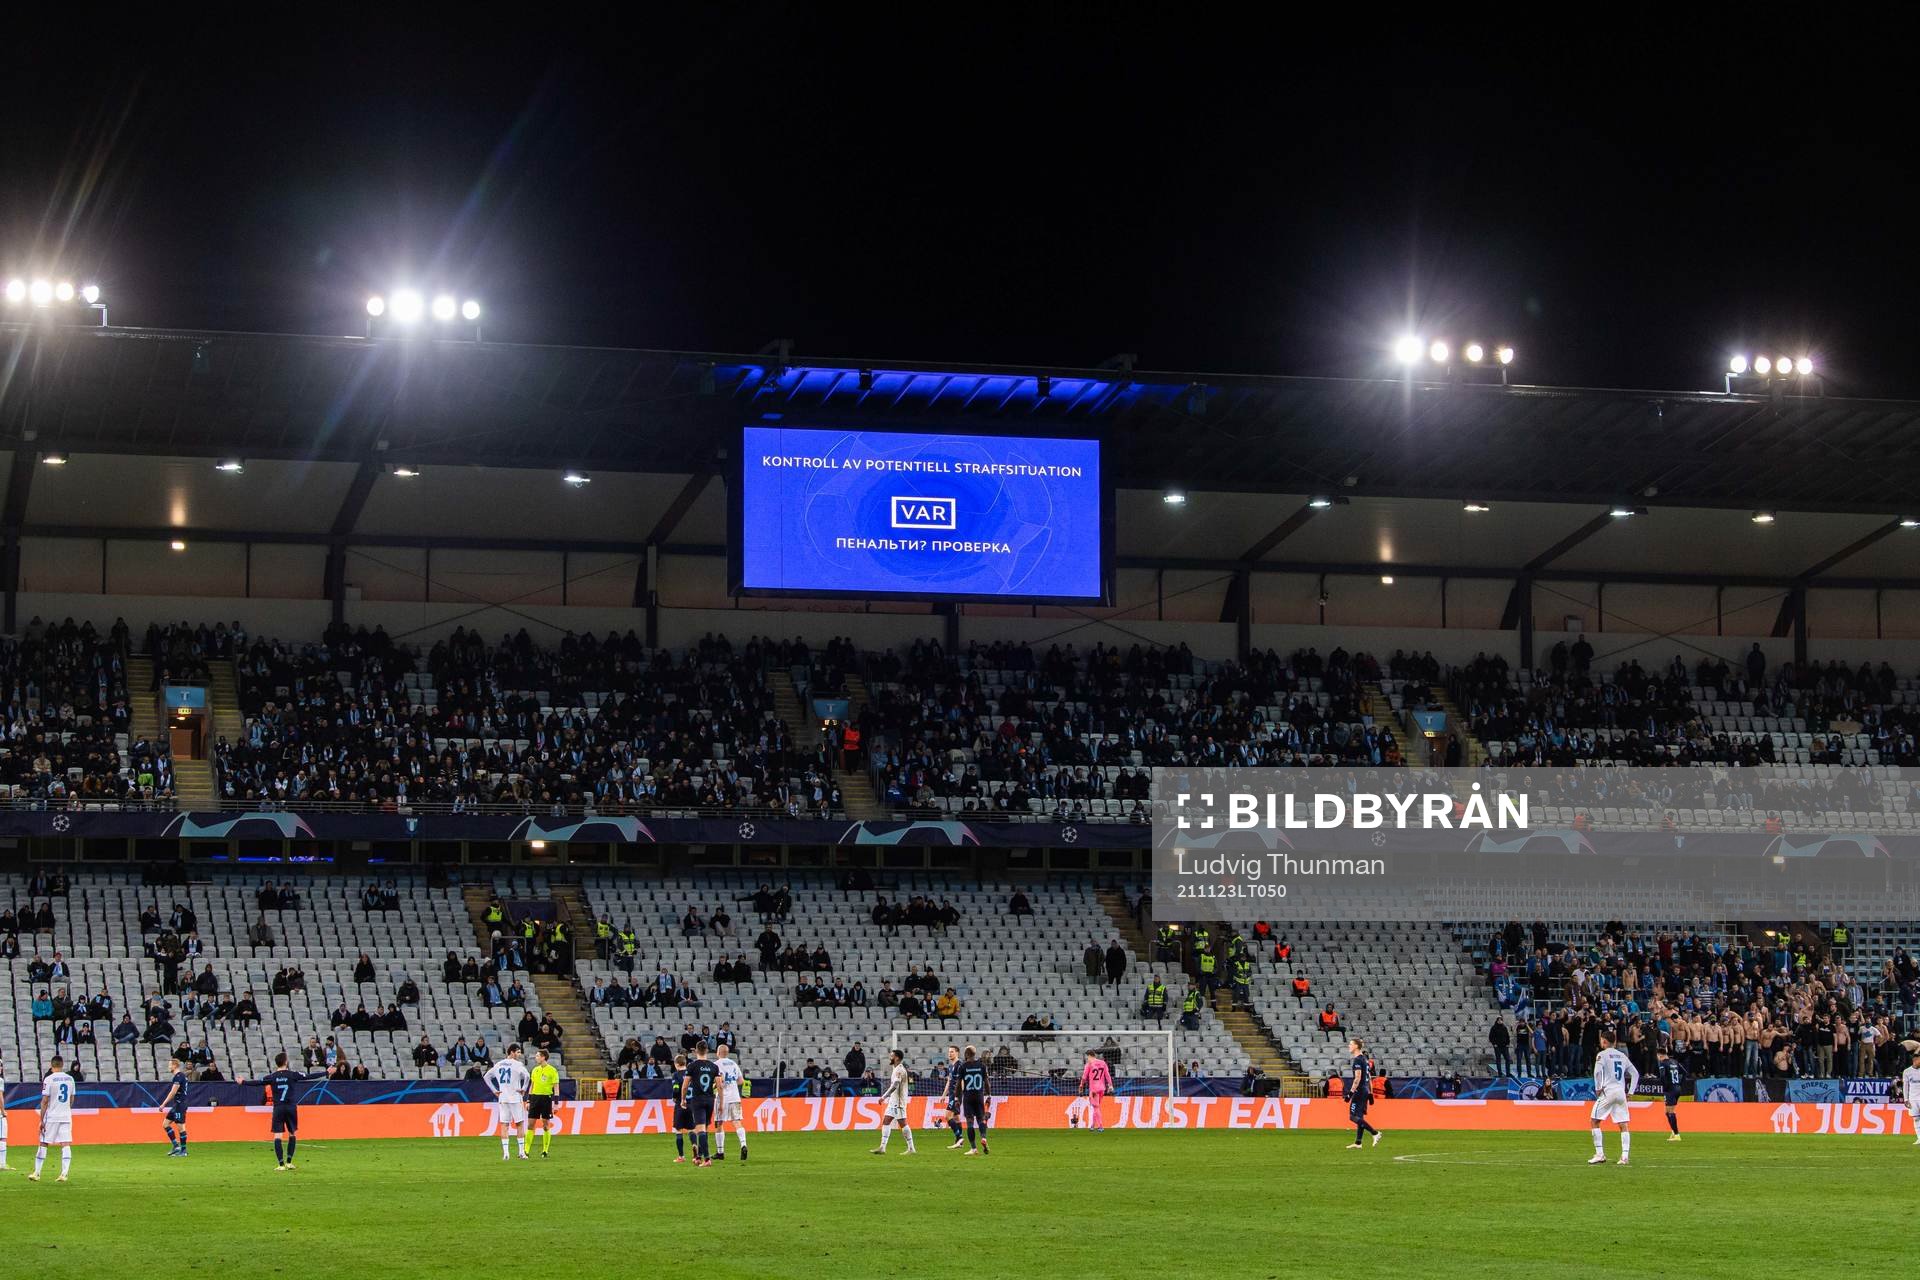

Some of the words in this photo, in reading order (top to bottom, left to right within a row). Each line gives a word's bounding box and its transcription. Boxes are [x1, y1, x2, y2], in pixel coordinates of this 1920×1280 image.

[762, 455, 839, 470] KONTROLL
[842, 458, 863, 470] AV
[865, 459, 951, 473] POTENTIELL
[954, 462, 1082, 478] STRAFFSITUATION
[901, 504, 946, 521] VAR
[836, 537, 927, 552] ПЕНАЛЬТИ?
[932, 540, 1011, 554] ПРОВЕРКА
[499, 1067, 511, 1084] 21
[1092, 1067, 1105, 1081] 27
[1614, 1061, 1623, 1081] 5
[1670, 1069, 1679, 1084] 13
[700, 1074, 710, 1092] 9
[964, 1073, 983, 1090] 20
[1847, 1081, 1891, 1095] ZENIT
[58, 1083, 68, 1103] 3
[277, 1084, 289, 1102] 7
[1113, 1096, 1217, 1129] JUST
[1228, 1097, 1311, 1129] EAT
[1814, 1103, 1911, 1135] JUST
